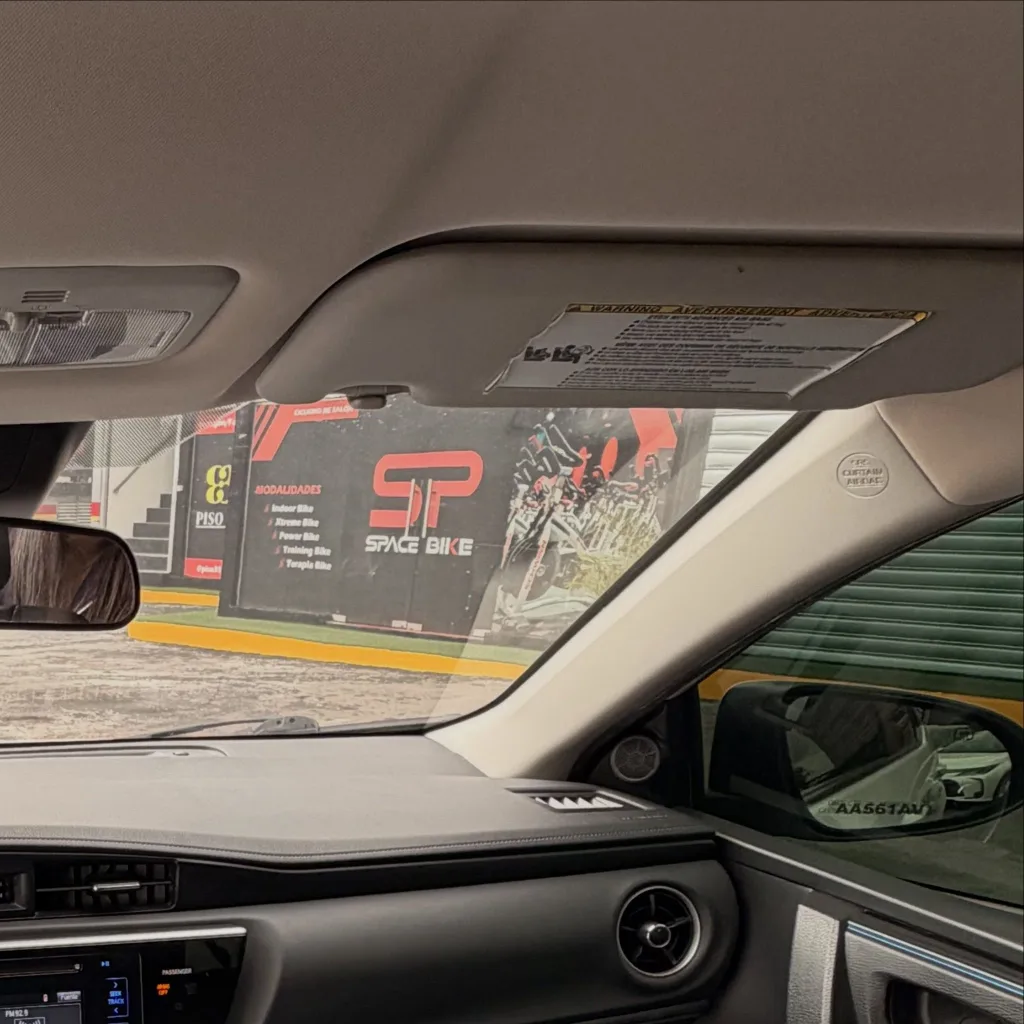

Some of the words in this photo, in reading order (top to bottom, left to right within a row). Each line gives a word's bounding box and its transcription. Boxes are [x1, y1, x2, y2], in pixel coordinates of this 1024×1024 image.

[592, 305, 661, 314] WARNING
[255, 484, 322, 495] MODALIDADES
[297, 504, 314, 513] Bike
[195, 511, 224, 526] PISO
[302, 518, 319, 527] Bike
[279, 531, 302, 541] Power
[303, 532, 320, 541] Bike
[364, 535, 420, 554] SPACE
[425, 536, 474, 556] BIKE
[283, 546, 313, 557] Training
[314, 547, 331, 556] Bike
[315, 561, 332, 570] Bike
